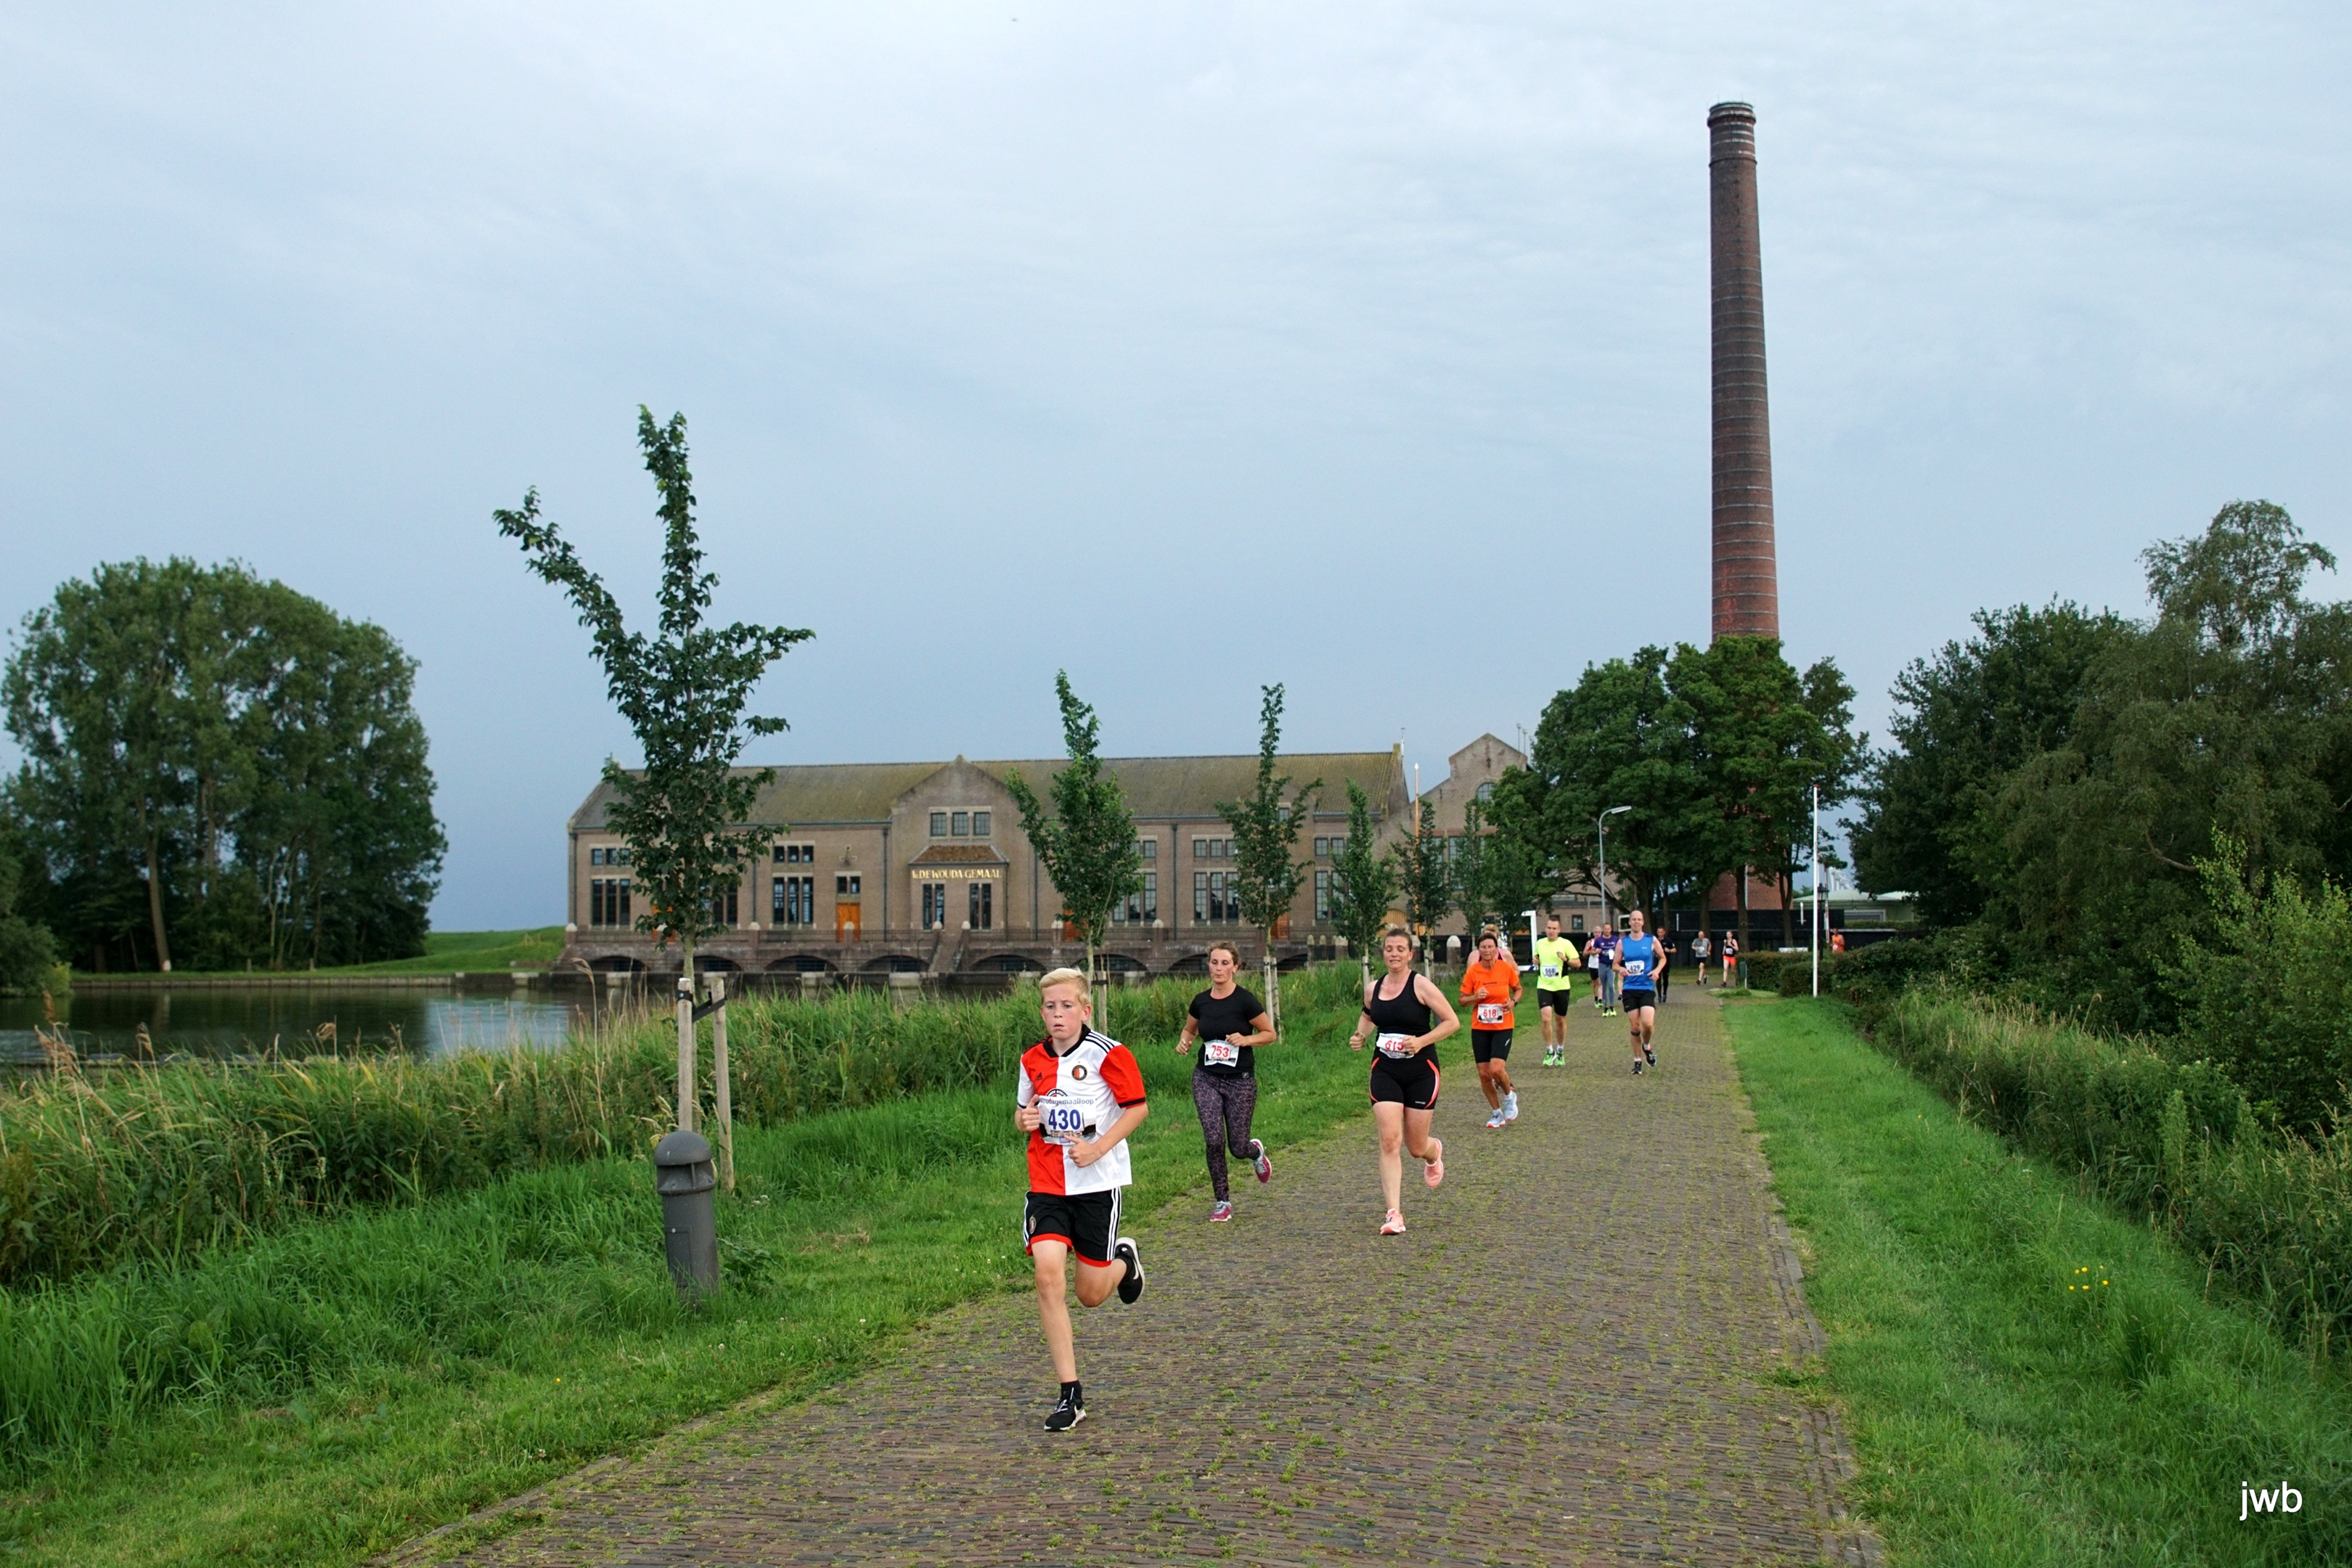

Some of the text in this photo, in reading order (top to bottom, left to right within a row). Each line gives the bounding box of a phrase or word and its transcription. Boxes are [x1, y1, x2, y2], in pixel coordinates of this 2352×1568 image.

[1483, 1008, 1497, 1018] 618
[1212, 1045, 1230, 1058] 753
[1048, 1108, 1081, 1130] 430
